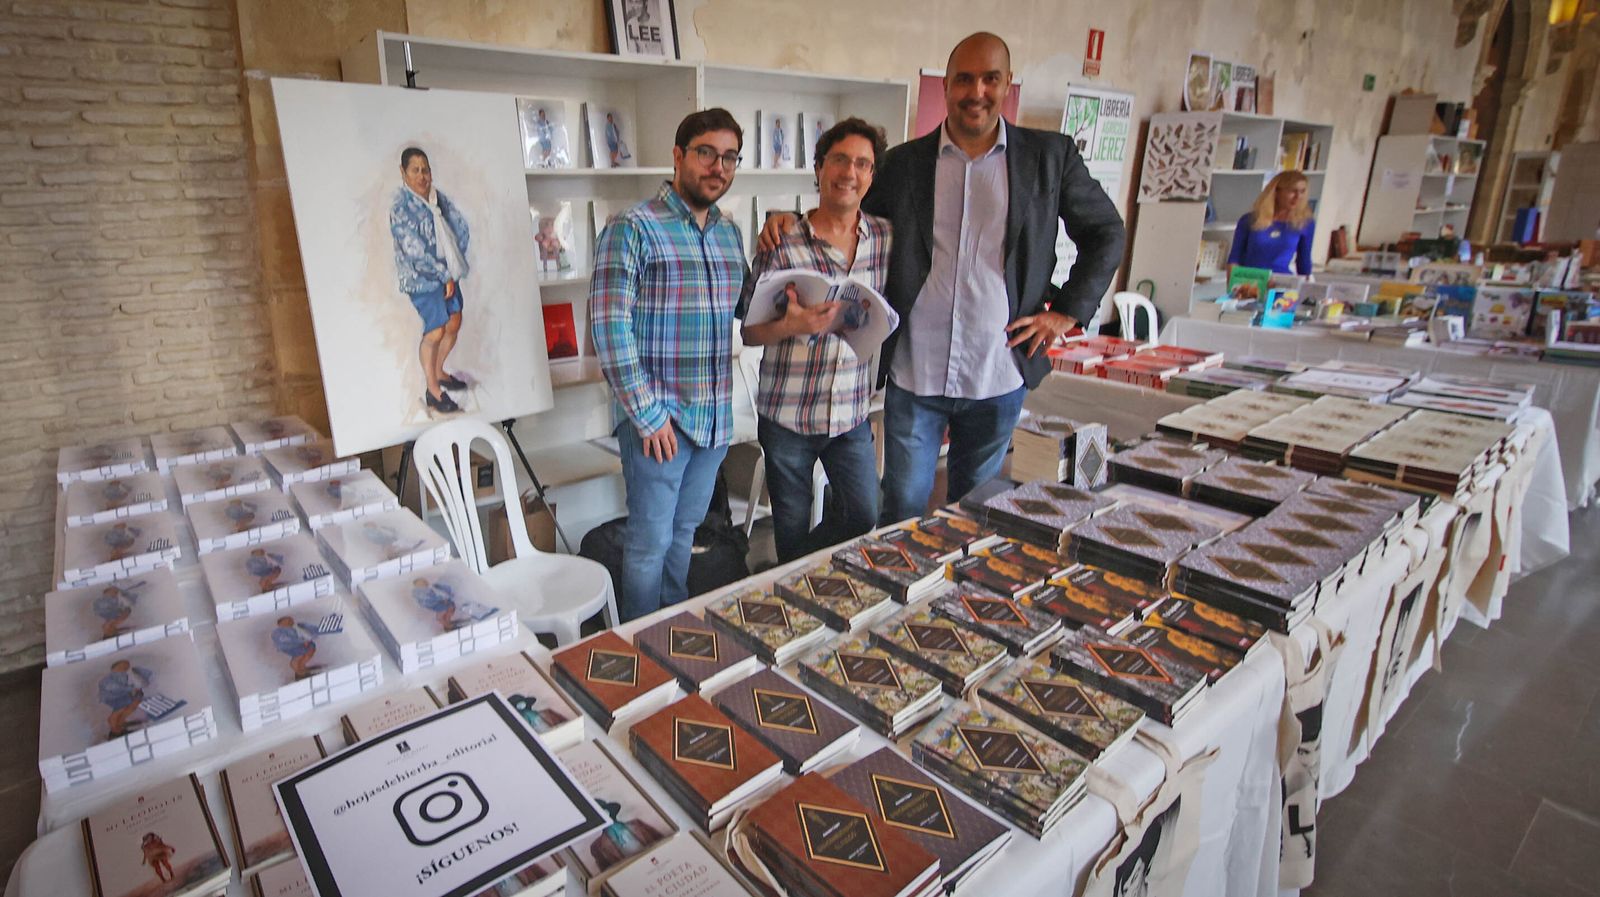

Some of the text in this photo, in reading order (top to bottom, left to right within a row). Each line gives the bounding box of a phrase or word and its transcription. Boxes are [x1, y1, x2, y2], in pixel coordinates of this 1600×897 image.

[628, 24, 661, 43] LEE
[1100, 98, 1131, 119] LIBRERÍA
[1094, 136, 1126, 161] JEREZ
[333, 733, 498, 817] @hojasdehierba_editorial
[415, 822, 520, 885] ¡SÍGUENOS!
